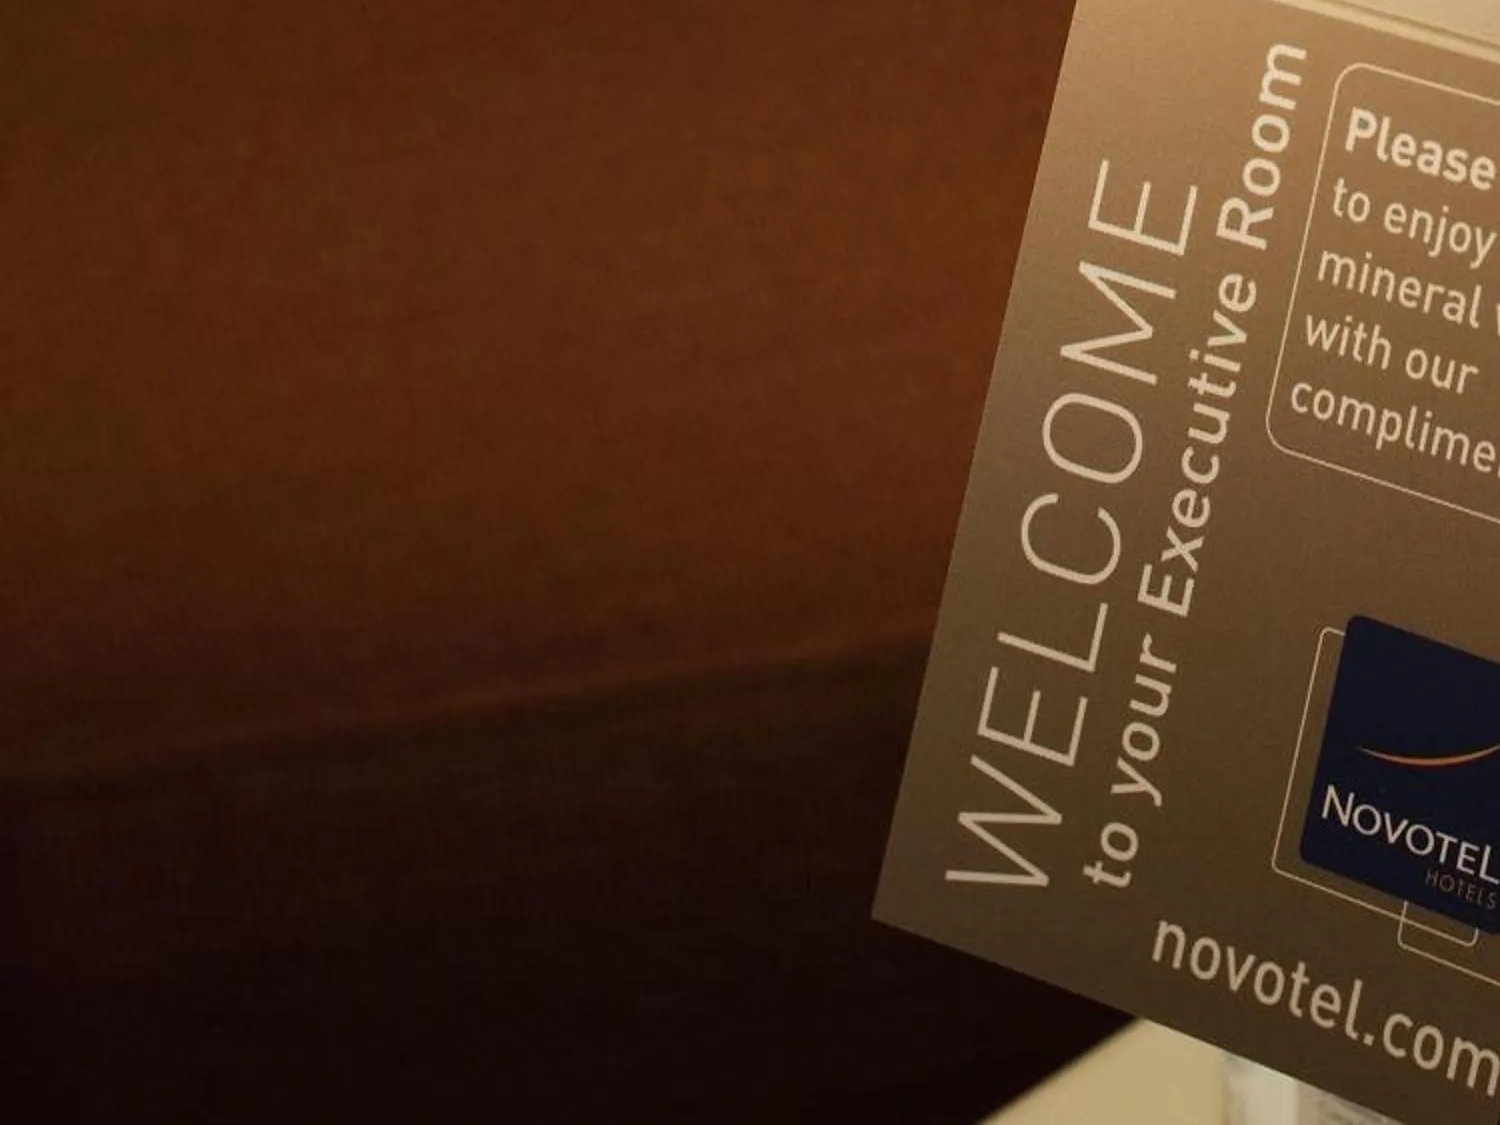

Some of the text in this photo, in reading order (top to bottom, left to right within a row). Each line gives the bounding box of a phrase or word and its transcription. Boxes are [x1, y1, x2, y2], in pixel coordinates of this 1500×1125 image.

[1345, 107, 1497, 191] Please
[1331, 178, 1371, 223] to
[1383, 203, 1498, 270] enjoy
[1317, 250, 1483, 329] mineral
[1305, 313, 1480, 395] with our
[1083, 43, 1307, 888] to your Executive Room
[945, 159, 1198, 887] WELCOME
[1321, 784, 1500, 885] NOVOTEL
[1425, 868, 1499, 909] HOTELS
[1150, 919, 1500, 1098] novotel.com
